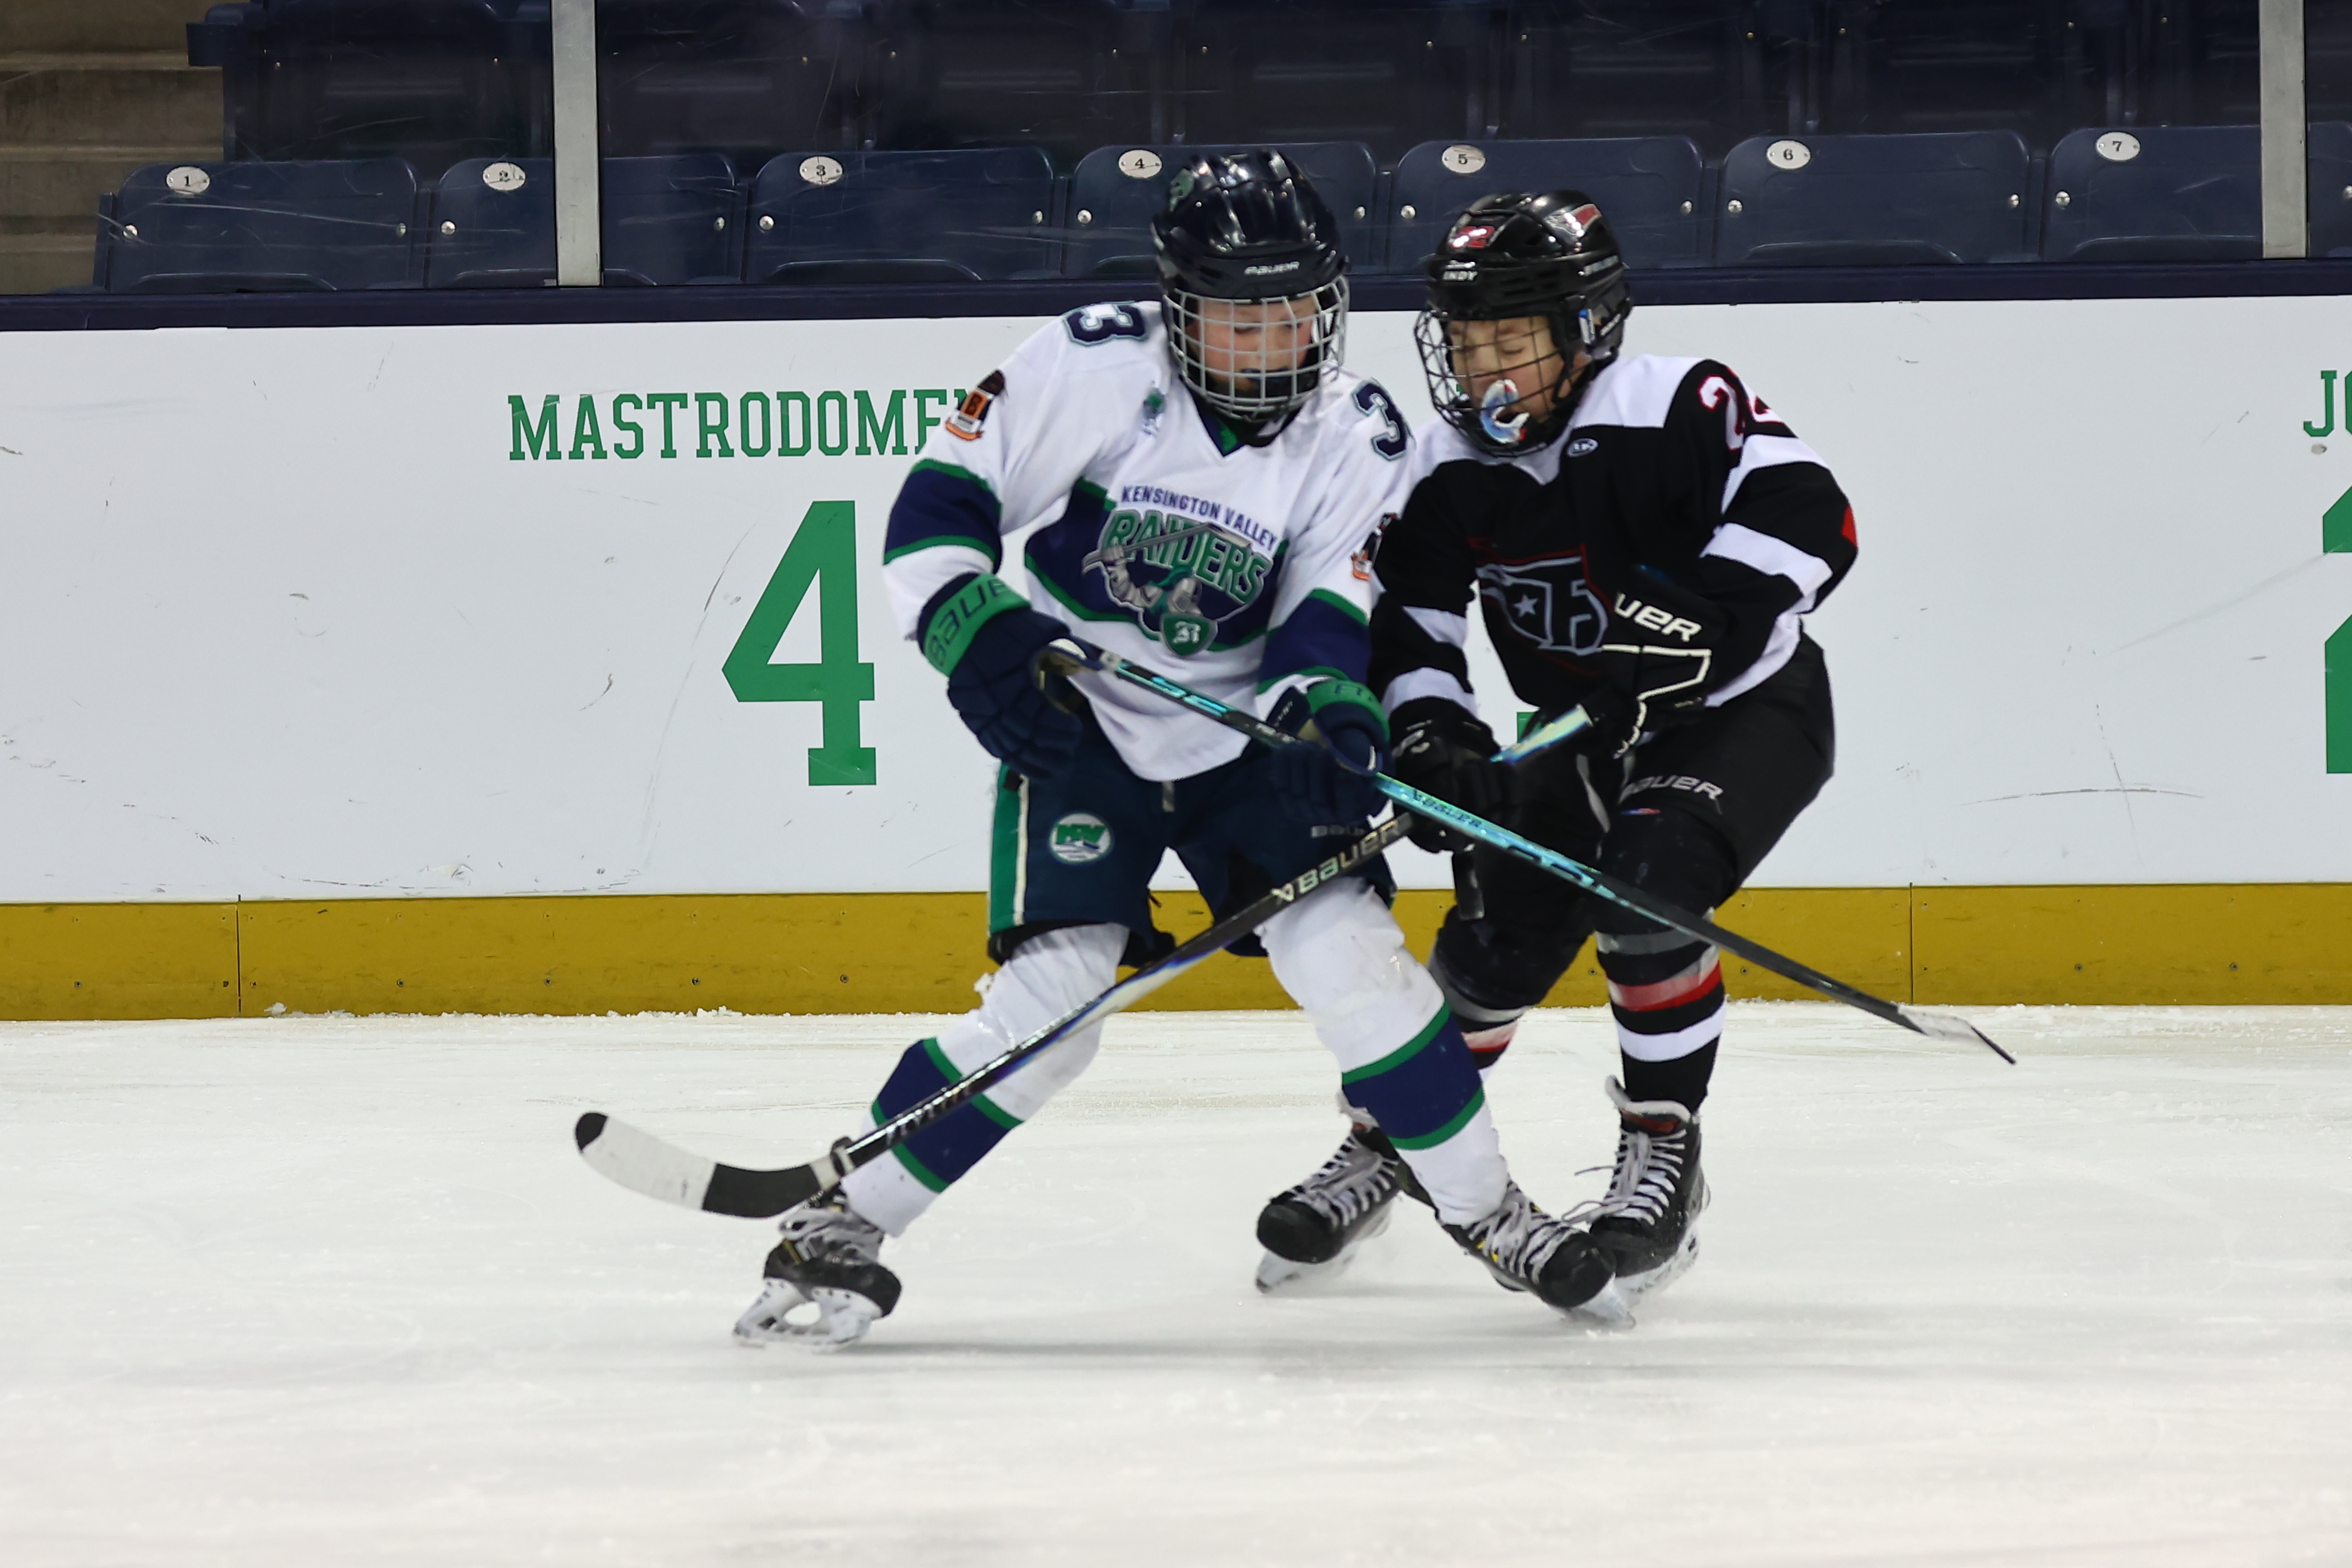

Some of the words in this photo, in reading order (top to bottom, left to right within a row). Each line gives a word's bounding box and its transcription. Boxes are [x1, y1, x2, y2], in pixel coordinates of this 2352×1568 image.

[816, 165, 826, 176] 3
[1135, 158, 1145, 169] 4
[1458, 153, 1468, 165] 5
[1783, 148, 1794, 160] 6
[2112, 141, 2122, 151] 7
[184, 175, 191, 187] 1
[1062, 300, 1149, 347] 3
[508, 388, 968, 461] MASTRODOME
[1351, 380, 1410, 461] 3
[2302, 369, 2352, 437] J
[1121, 485, 1221, 520] KENSINGTON
[1224, 505, 1278, 552] VALLEY
[1098, 509, 1274, 606] RAIDERS
[721, 499, 877, 787] 4
[1298, 819, 1399, 895] BAUER
